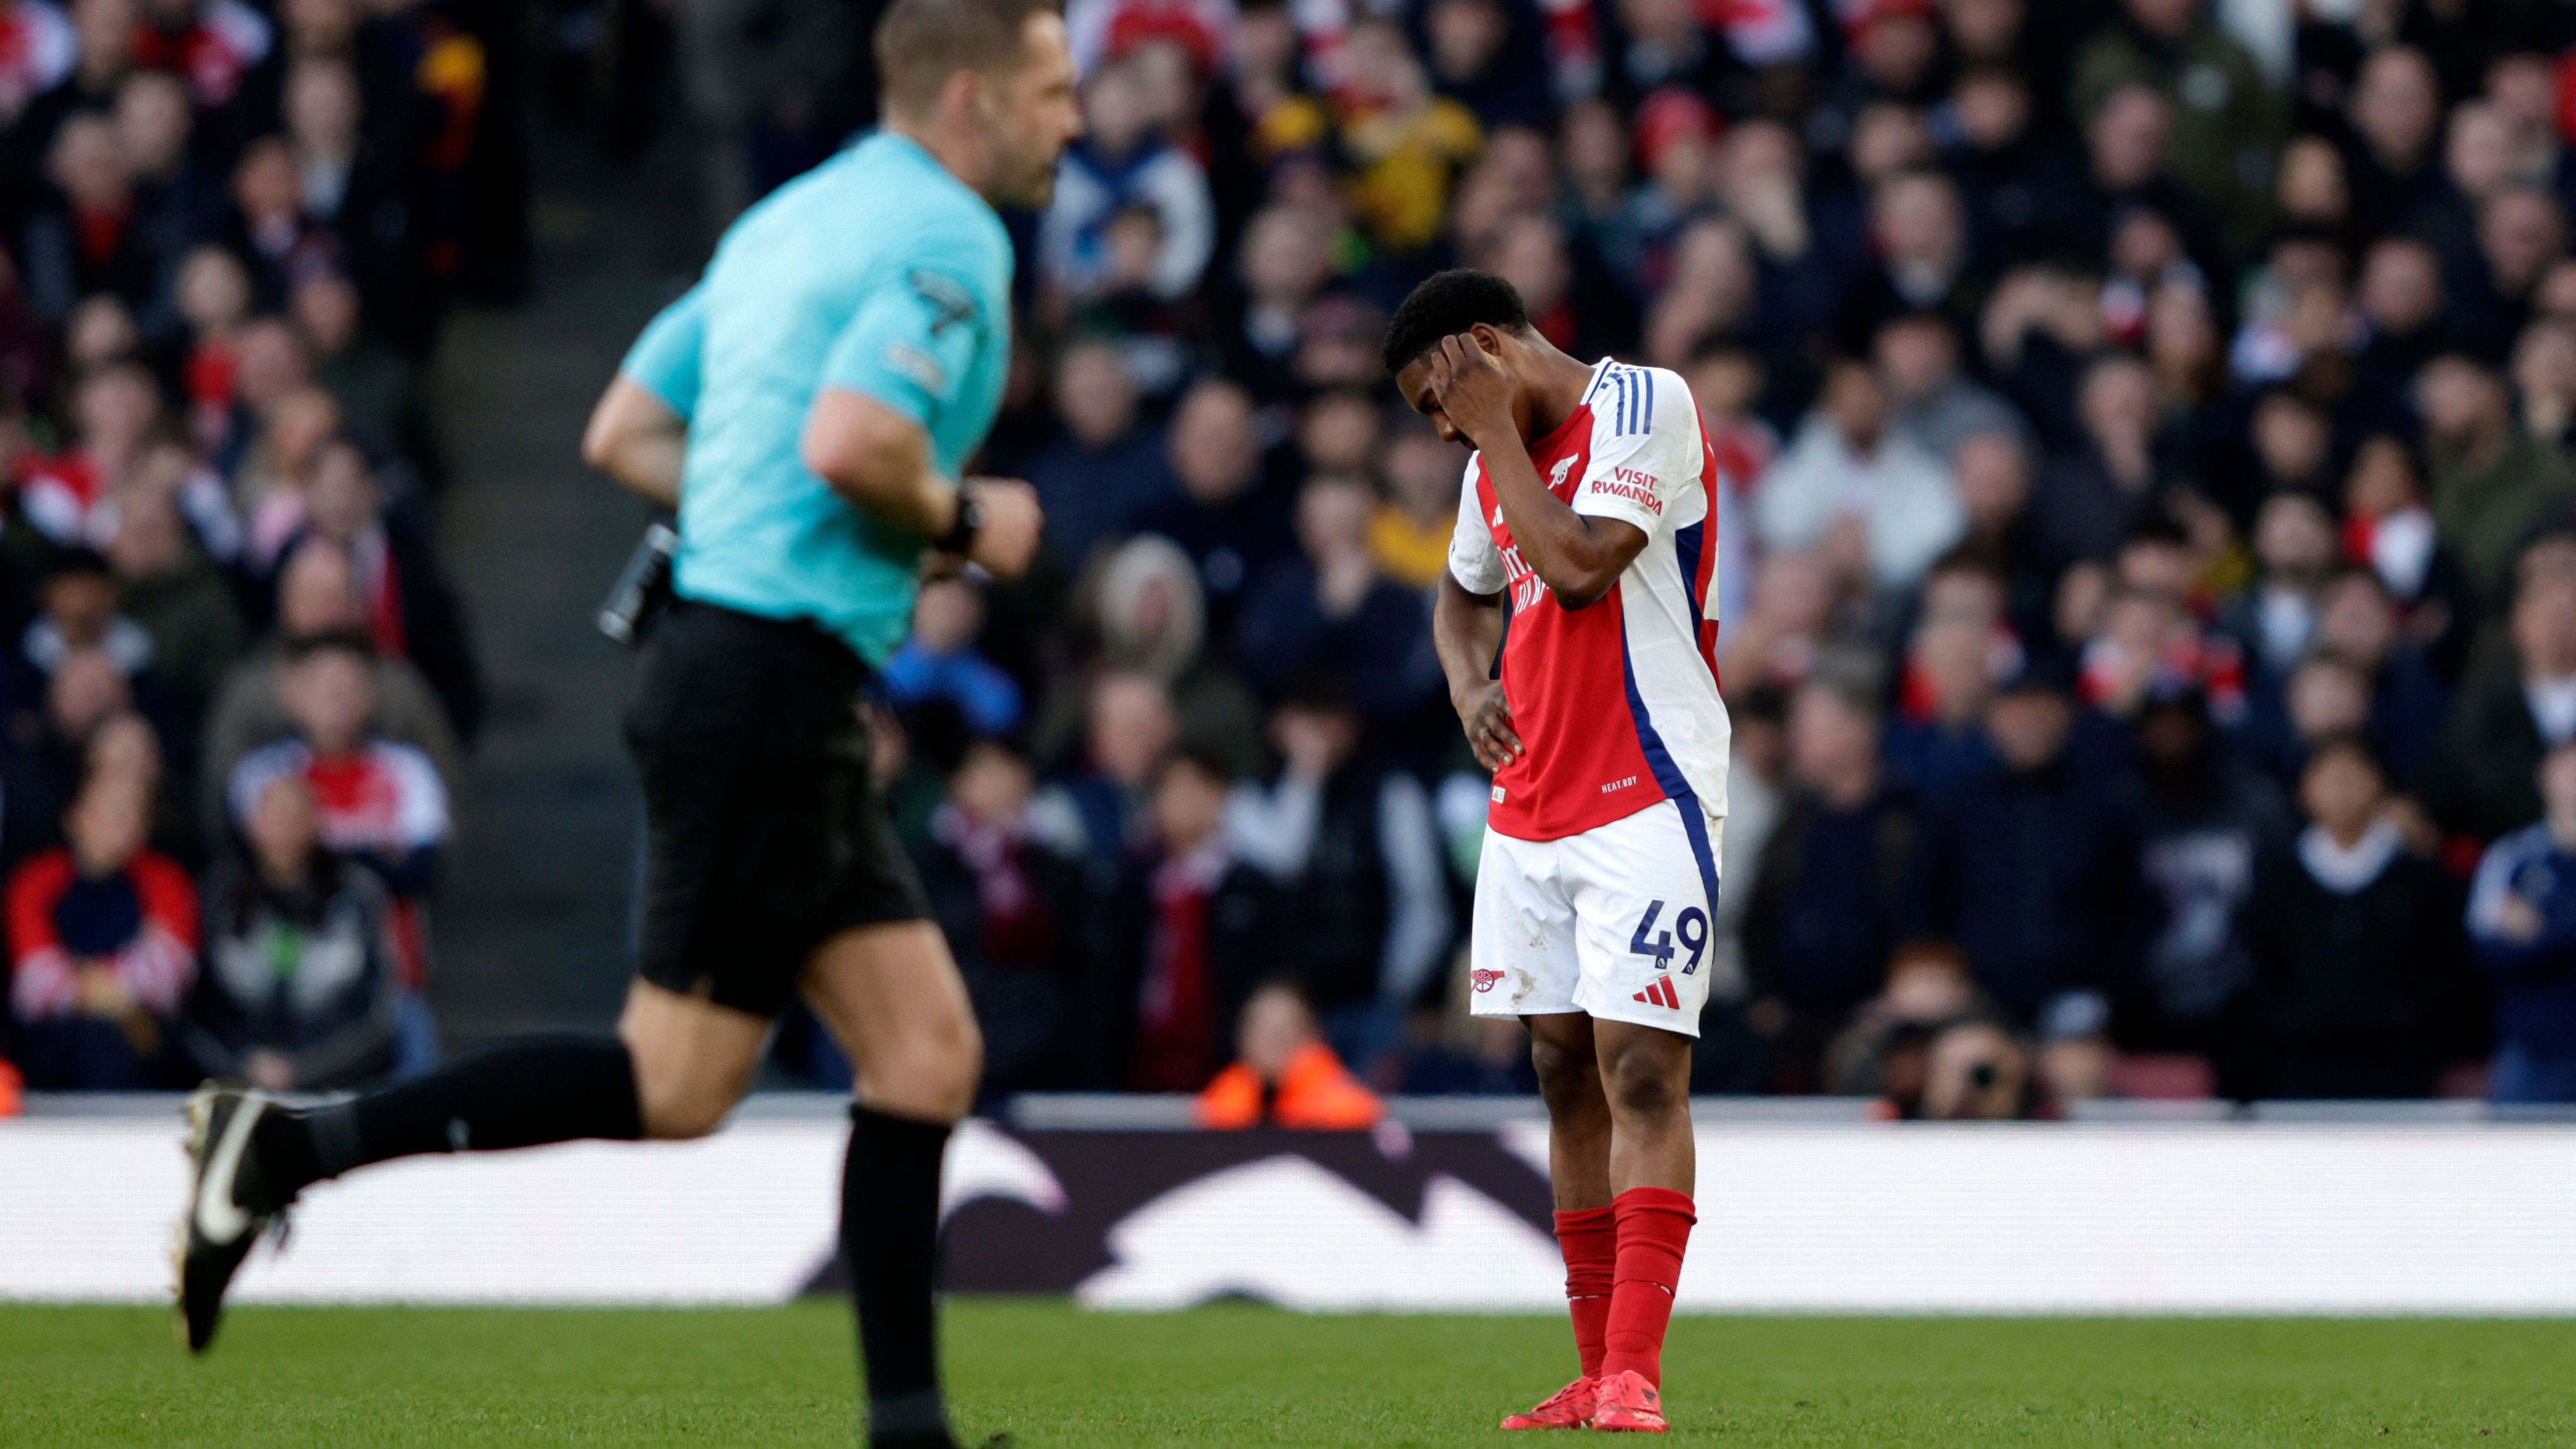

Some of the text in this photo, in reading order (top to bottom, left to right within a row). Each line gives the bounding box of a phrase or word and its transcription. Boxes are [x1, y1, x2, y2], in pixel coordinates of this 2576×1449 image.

[1615, 467, 1658, 490] VISIT
[1591, 481, 1663, 516] RWANDA
[1601, 775, 1637, 793] HEAT.RDY
[1630, 899, 1708, 975] 49
